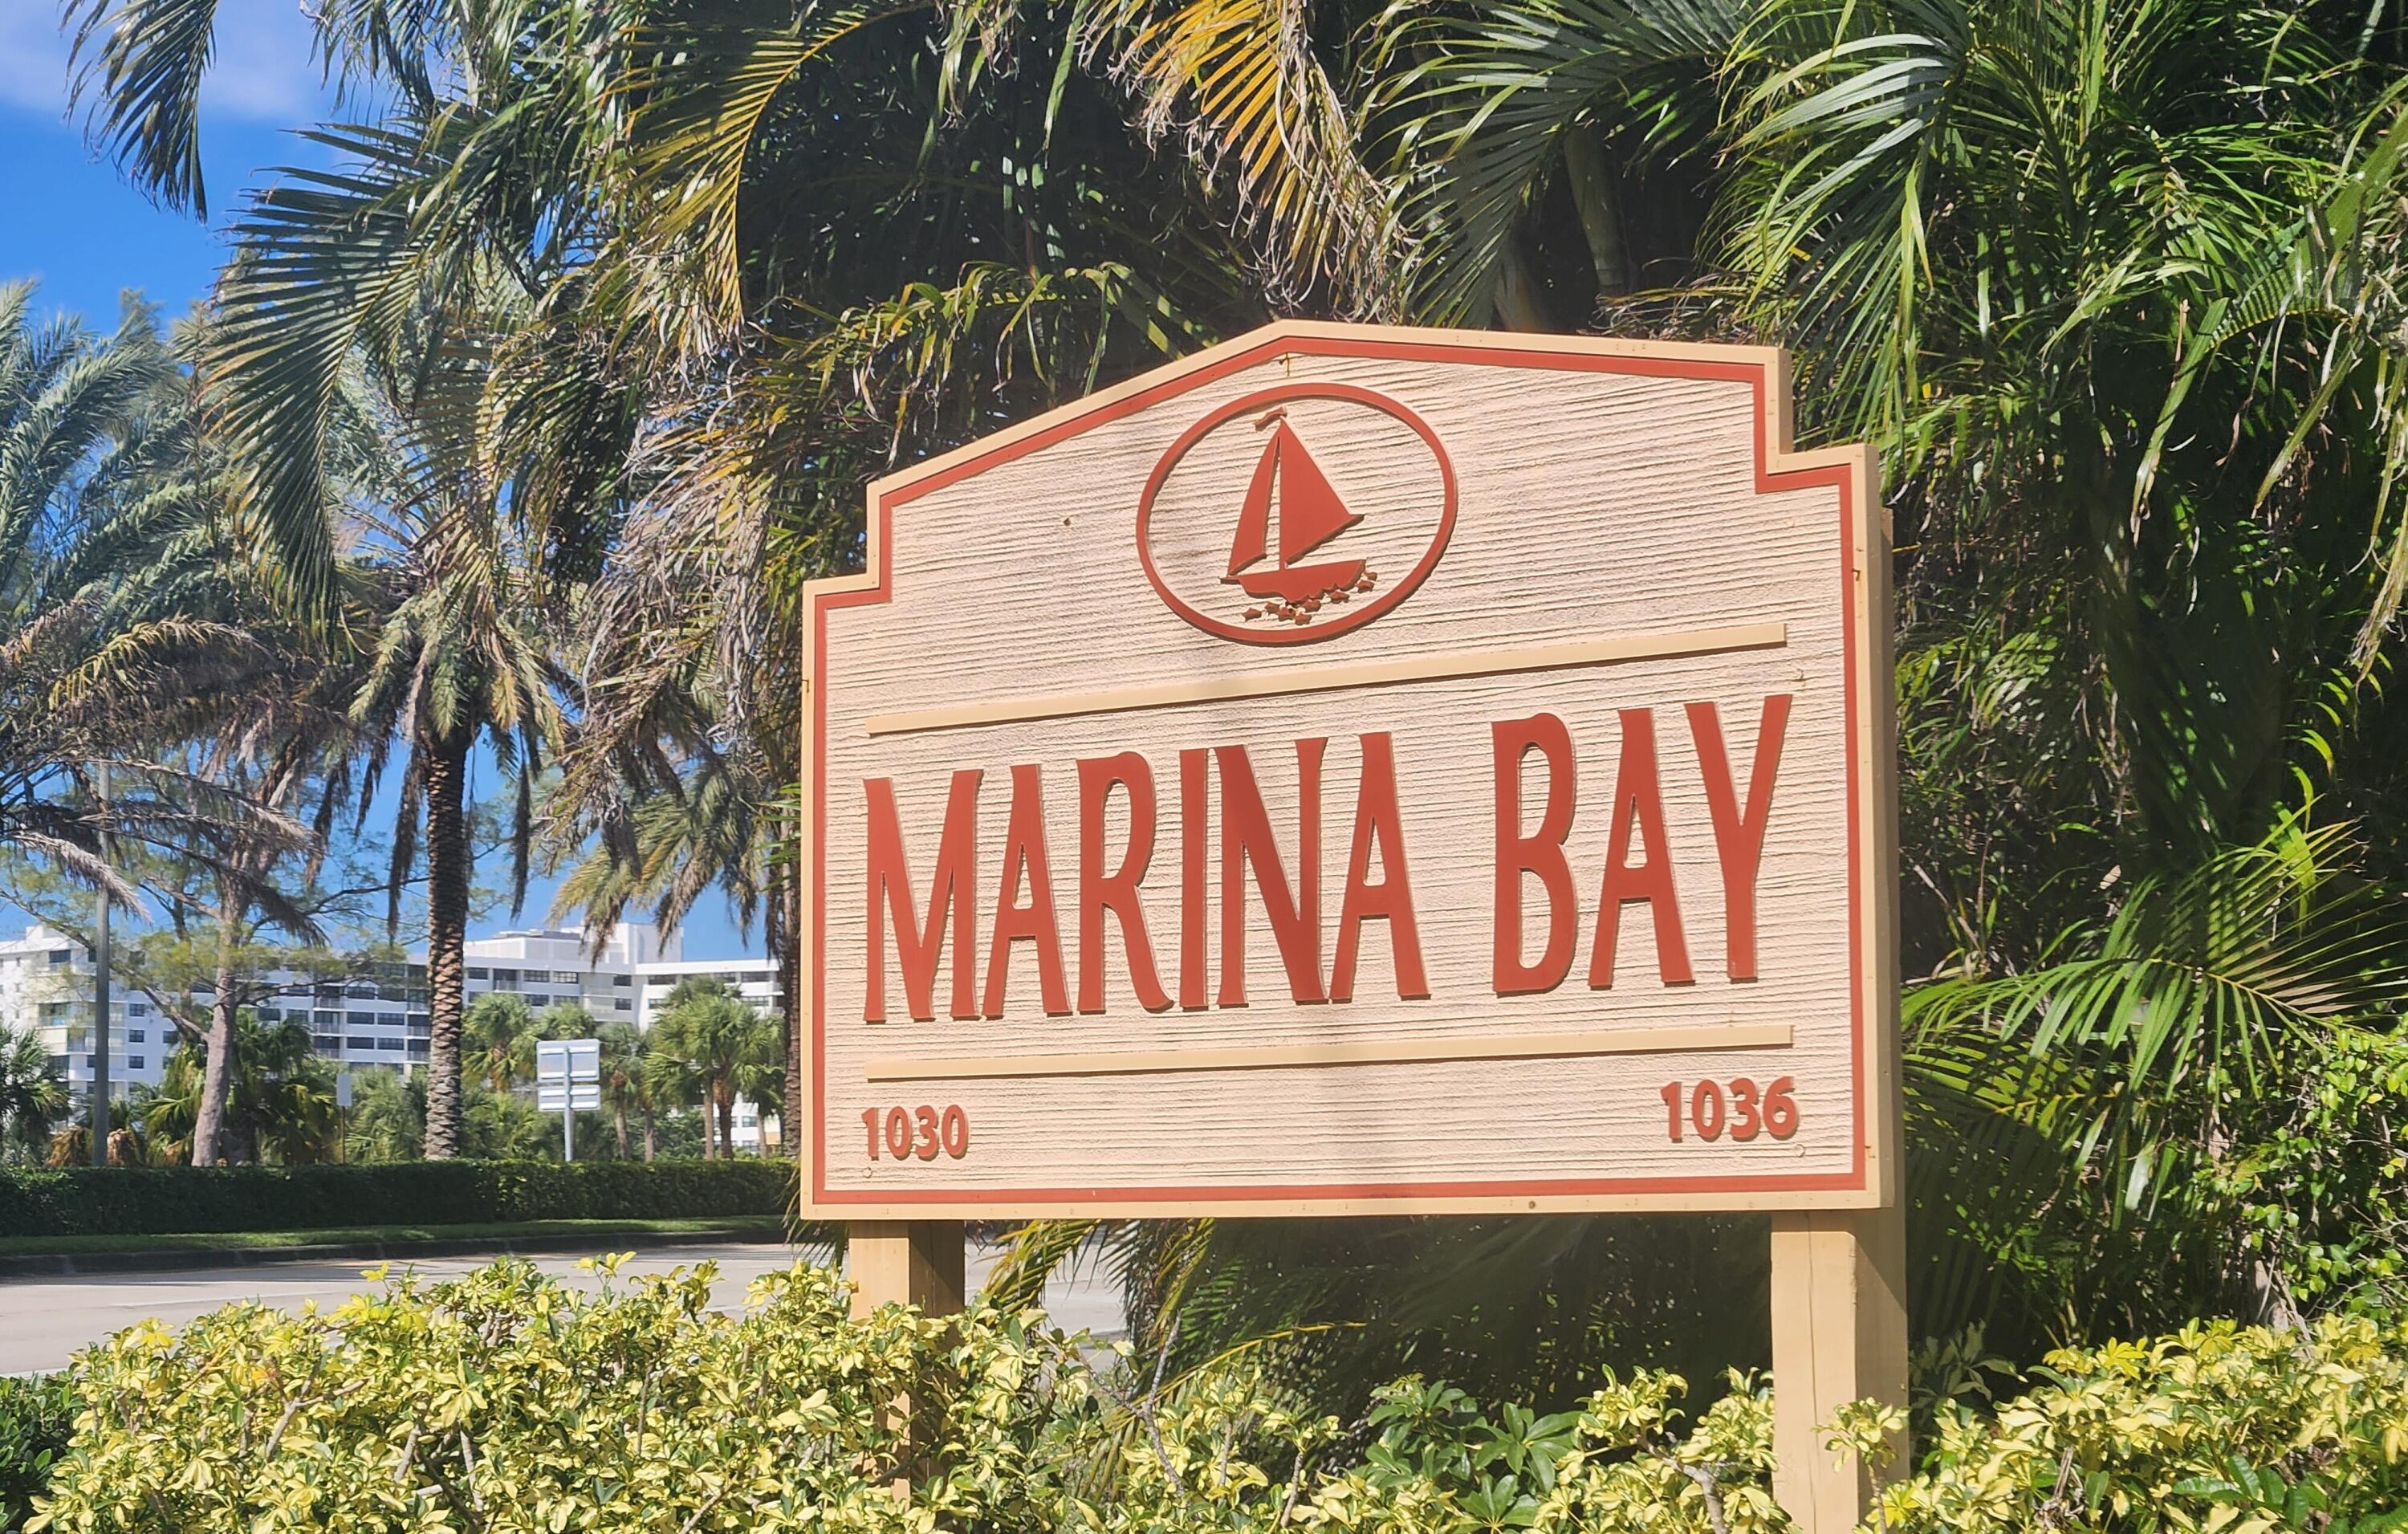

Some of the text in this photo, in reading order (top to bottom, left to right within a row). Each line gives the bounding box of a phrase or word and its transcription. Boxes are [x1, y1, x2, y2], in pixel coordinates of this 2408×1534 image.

[864, 694, 1792, 1023] MARINA BAY
[862, 1105, 968, 1161] 1030
[1660, 1076, 1799, 1142] 1036
